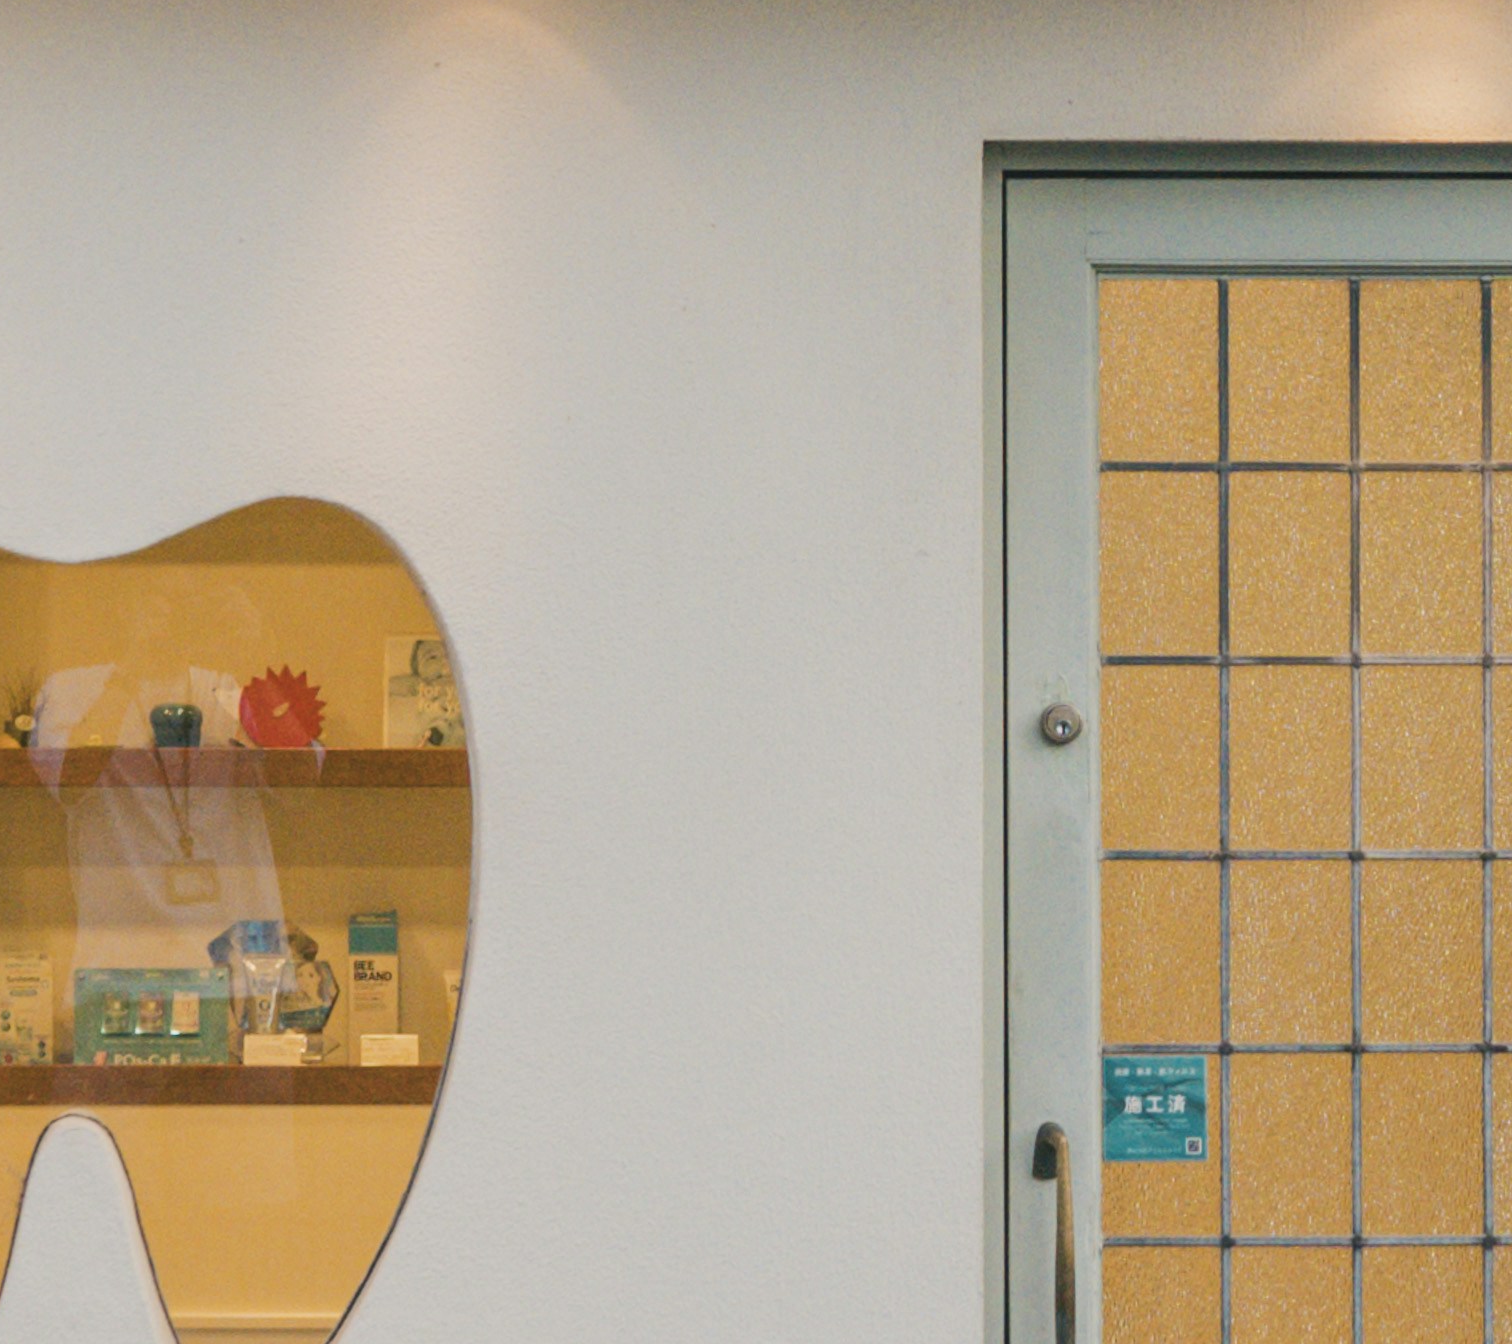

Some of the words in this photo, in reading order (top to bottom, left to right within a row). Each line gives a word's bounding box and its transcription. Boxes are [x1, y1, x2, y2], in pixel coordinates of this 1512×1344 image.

[354, 960, 375, 970] BEE
[354, 971, 392, 981] BRAND
[1124, 1094, 1186, 1115] 施工済
